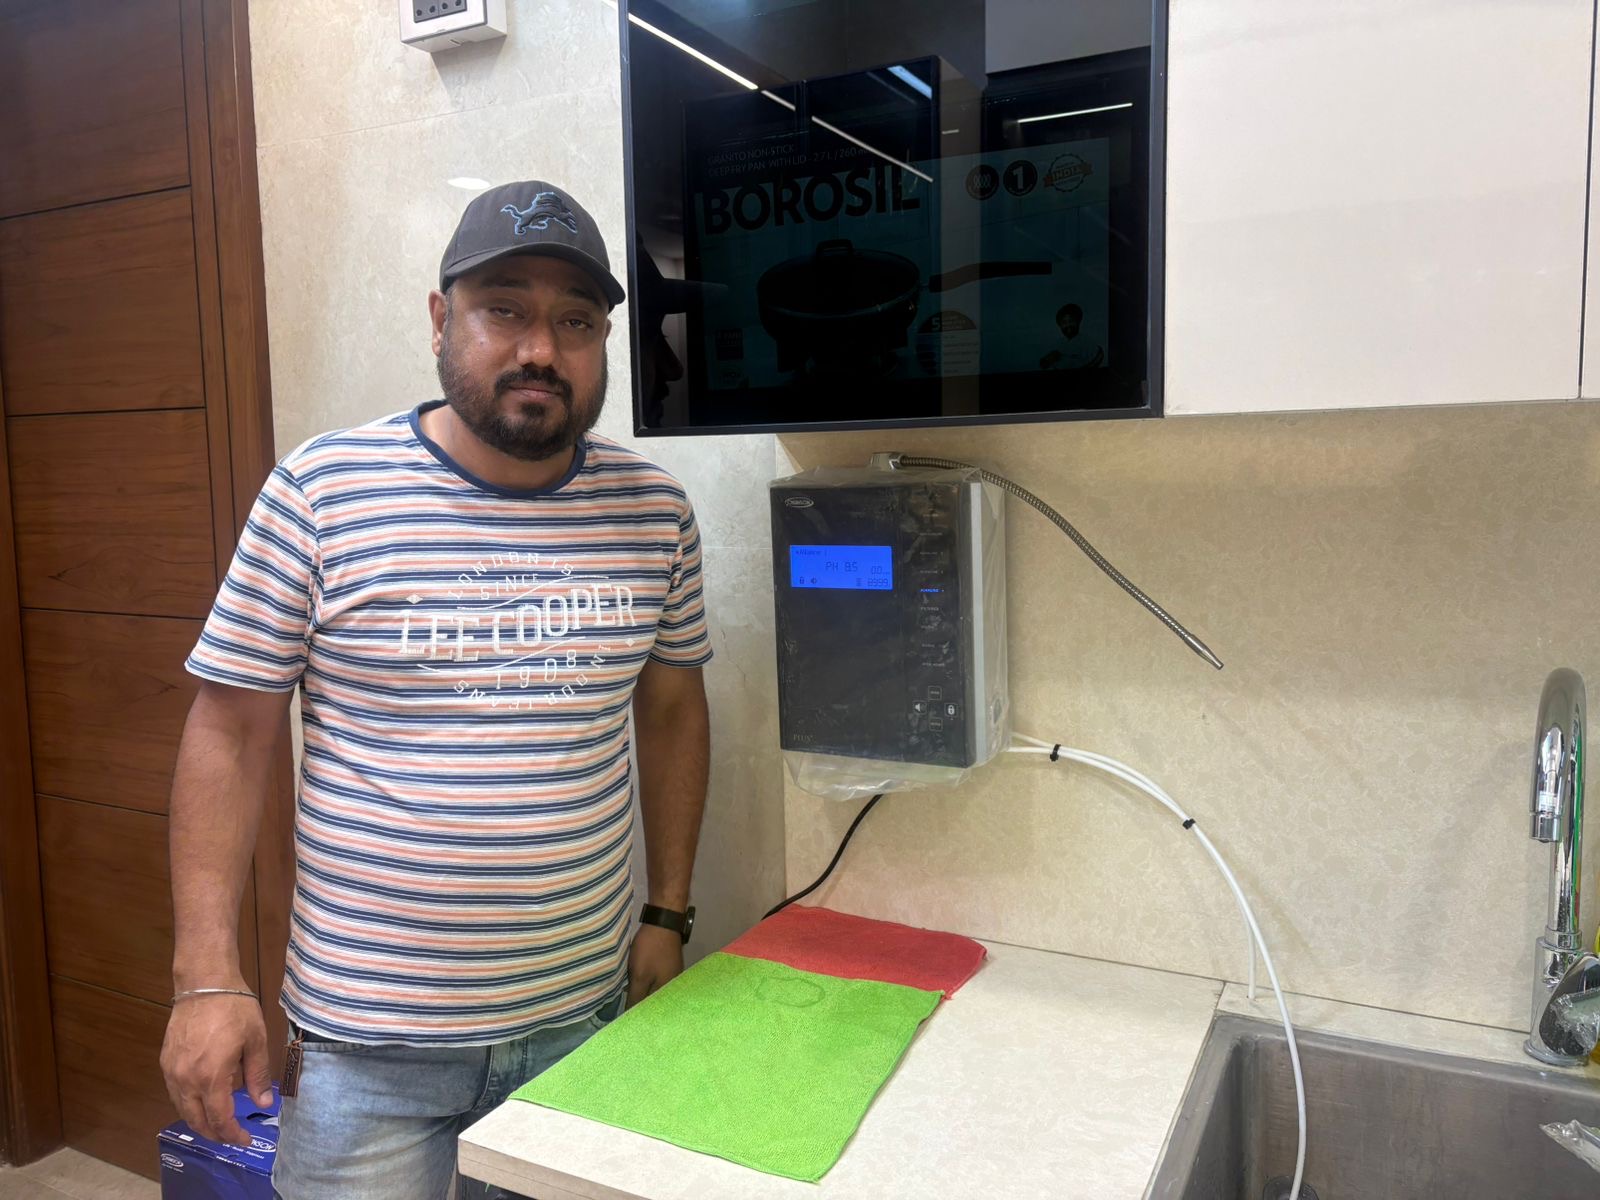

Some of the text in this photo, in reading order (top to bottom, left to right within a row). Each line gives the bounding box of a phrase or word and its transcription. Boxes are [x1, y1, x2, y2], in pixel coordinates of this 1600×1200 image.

[768, 151, 792, 168] WITH
[703, 164, 920, 234] BOROSIL
[480, 573, 539, 600] SINCE
[398, 582, 636, 662] LEE COOPER
[495, 649, 578, 690] 1908
